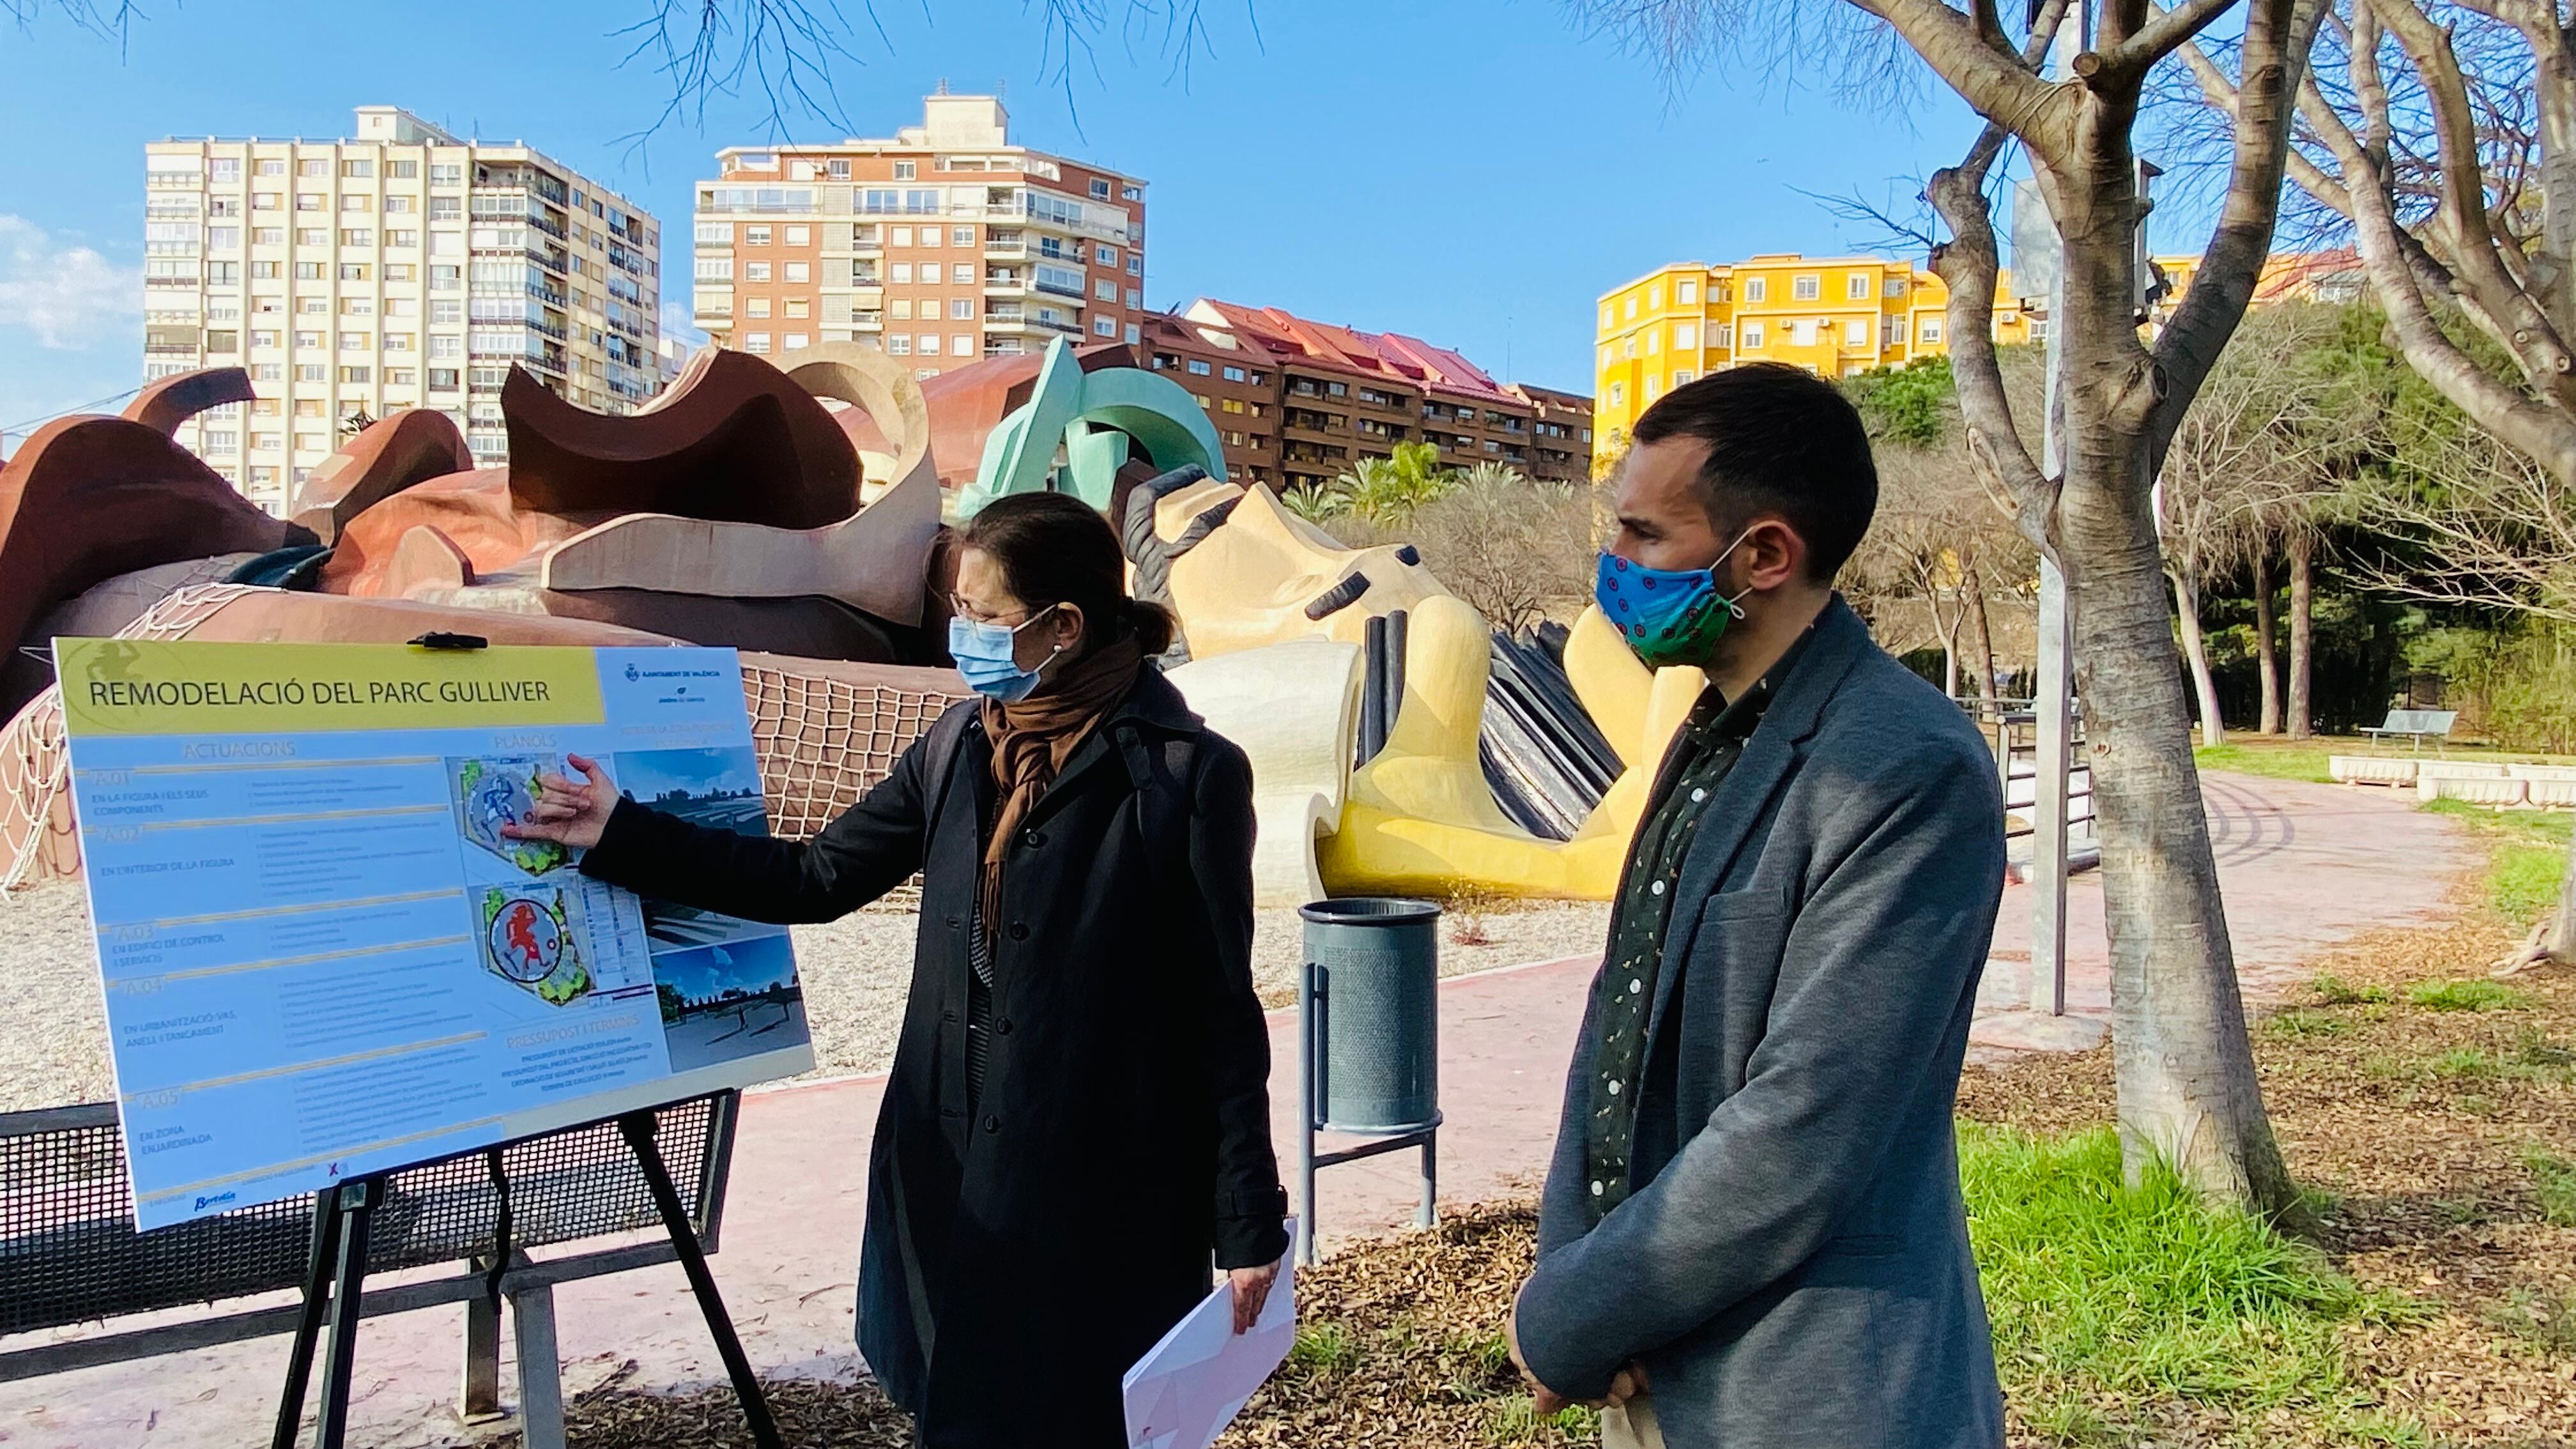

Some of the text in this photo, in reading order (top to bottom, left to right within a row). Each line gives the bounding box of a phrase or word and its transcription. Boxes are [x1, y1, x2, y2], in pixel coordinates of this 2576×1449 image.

[89, 678, 550, 707] REMODELACIÓ DEL PARC GULLIVER
[494, 733, 558, 749] PLÀNOLS
[183, 741, 297, 760] ACTUACIONS
[95, 772, 130, 786] A.01
[93, 804, 164, 816] COMPONENTS
[103, 827, 139, 843] A.02
[118, 926, 154, 942] A.03
[180, 934, 226, 946] CONTROL
[507, 1026, 579, 1048] PRESSUPOST
[588, 1014, 639, 1035] TERMINIS
[142, 1090, 178, 1109] A.05
[156, 1125, 185, 1139] ZONA
